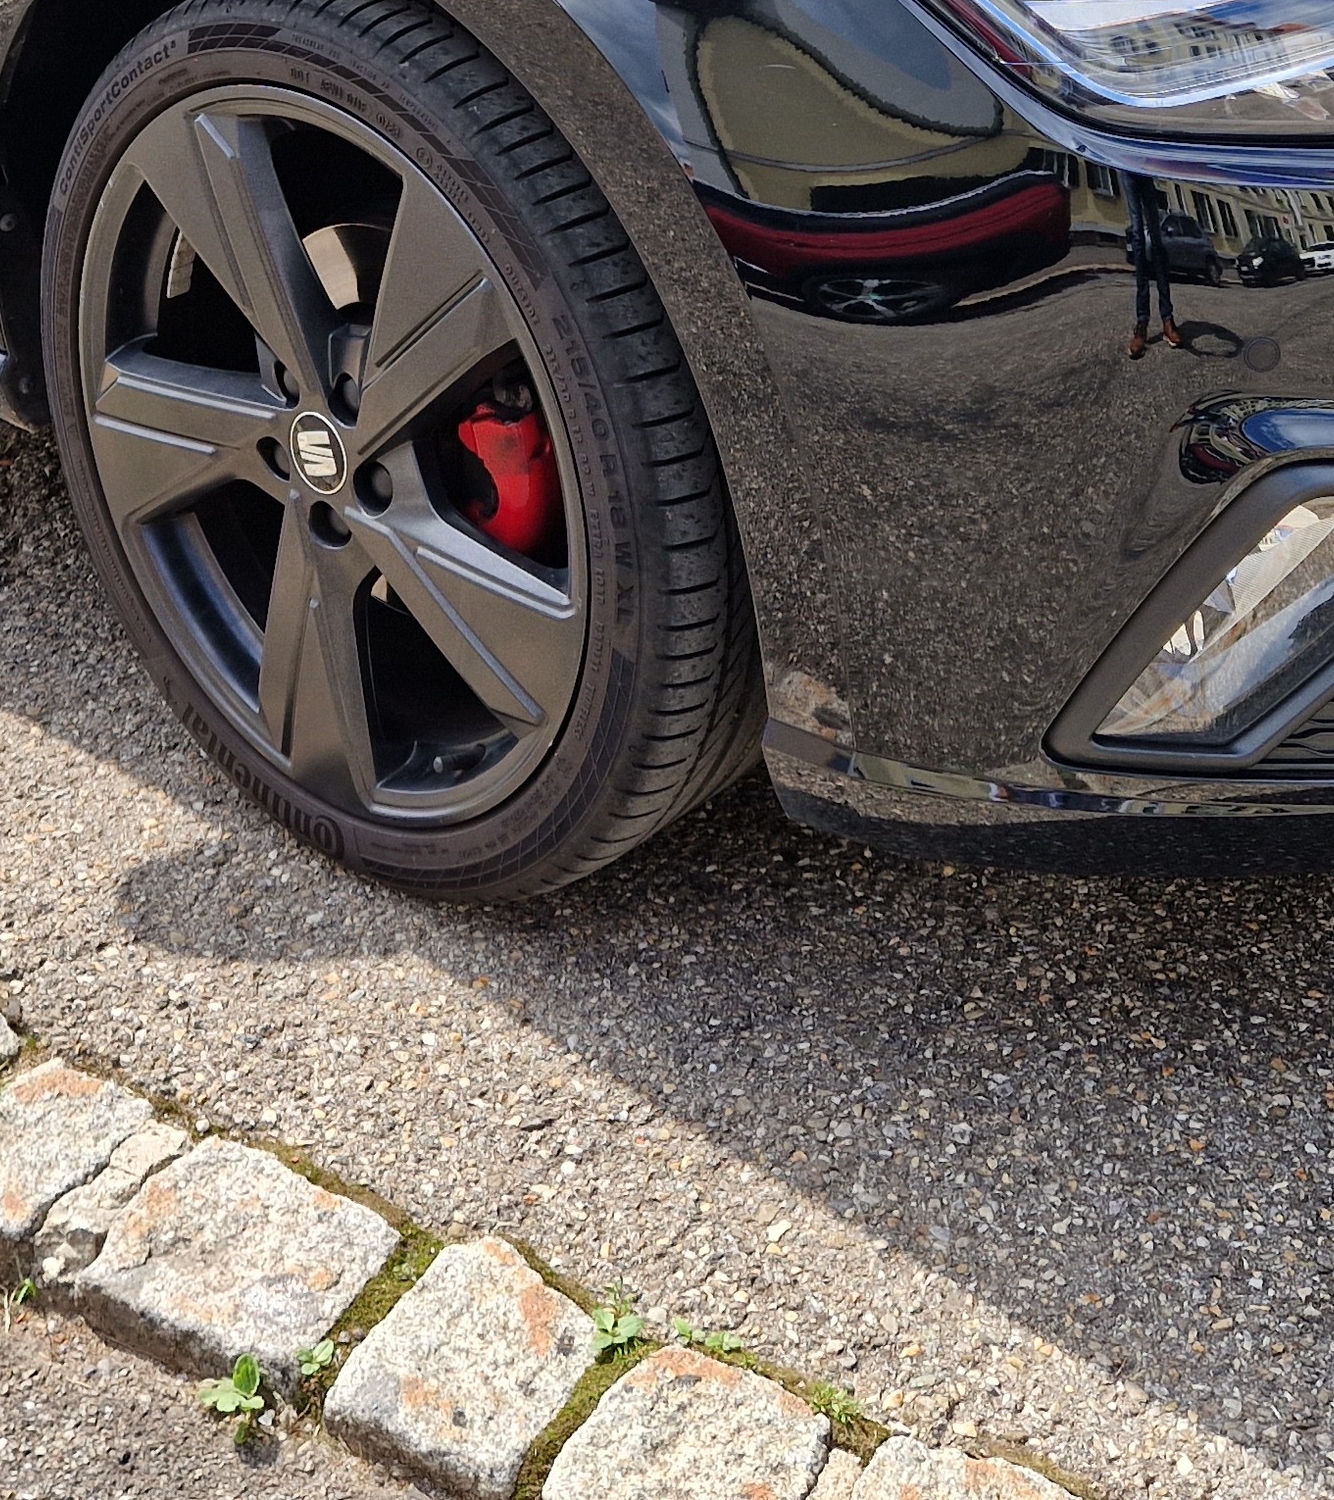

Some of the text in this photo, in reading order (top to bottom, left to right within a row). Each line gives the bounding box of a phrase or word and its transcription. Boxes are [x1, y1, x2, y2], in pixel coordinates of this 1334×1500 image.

[552, 313, 611, 441] 215/40
[598, 454, 619, 480] R
[606, 488, 627, 525] 18
[615, 579, 634, 633] XL
[181, 703, 346, 860] Continental
